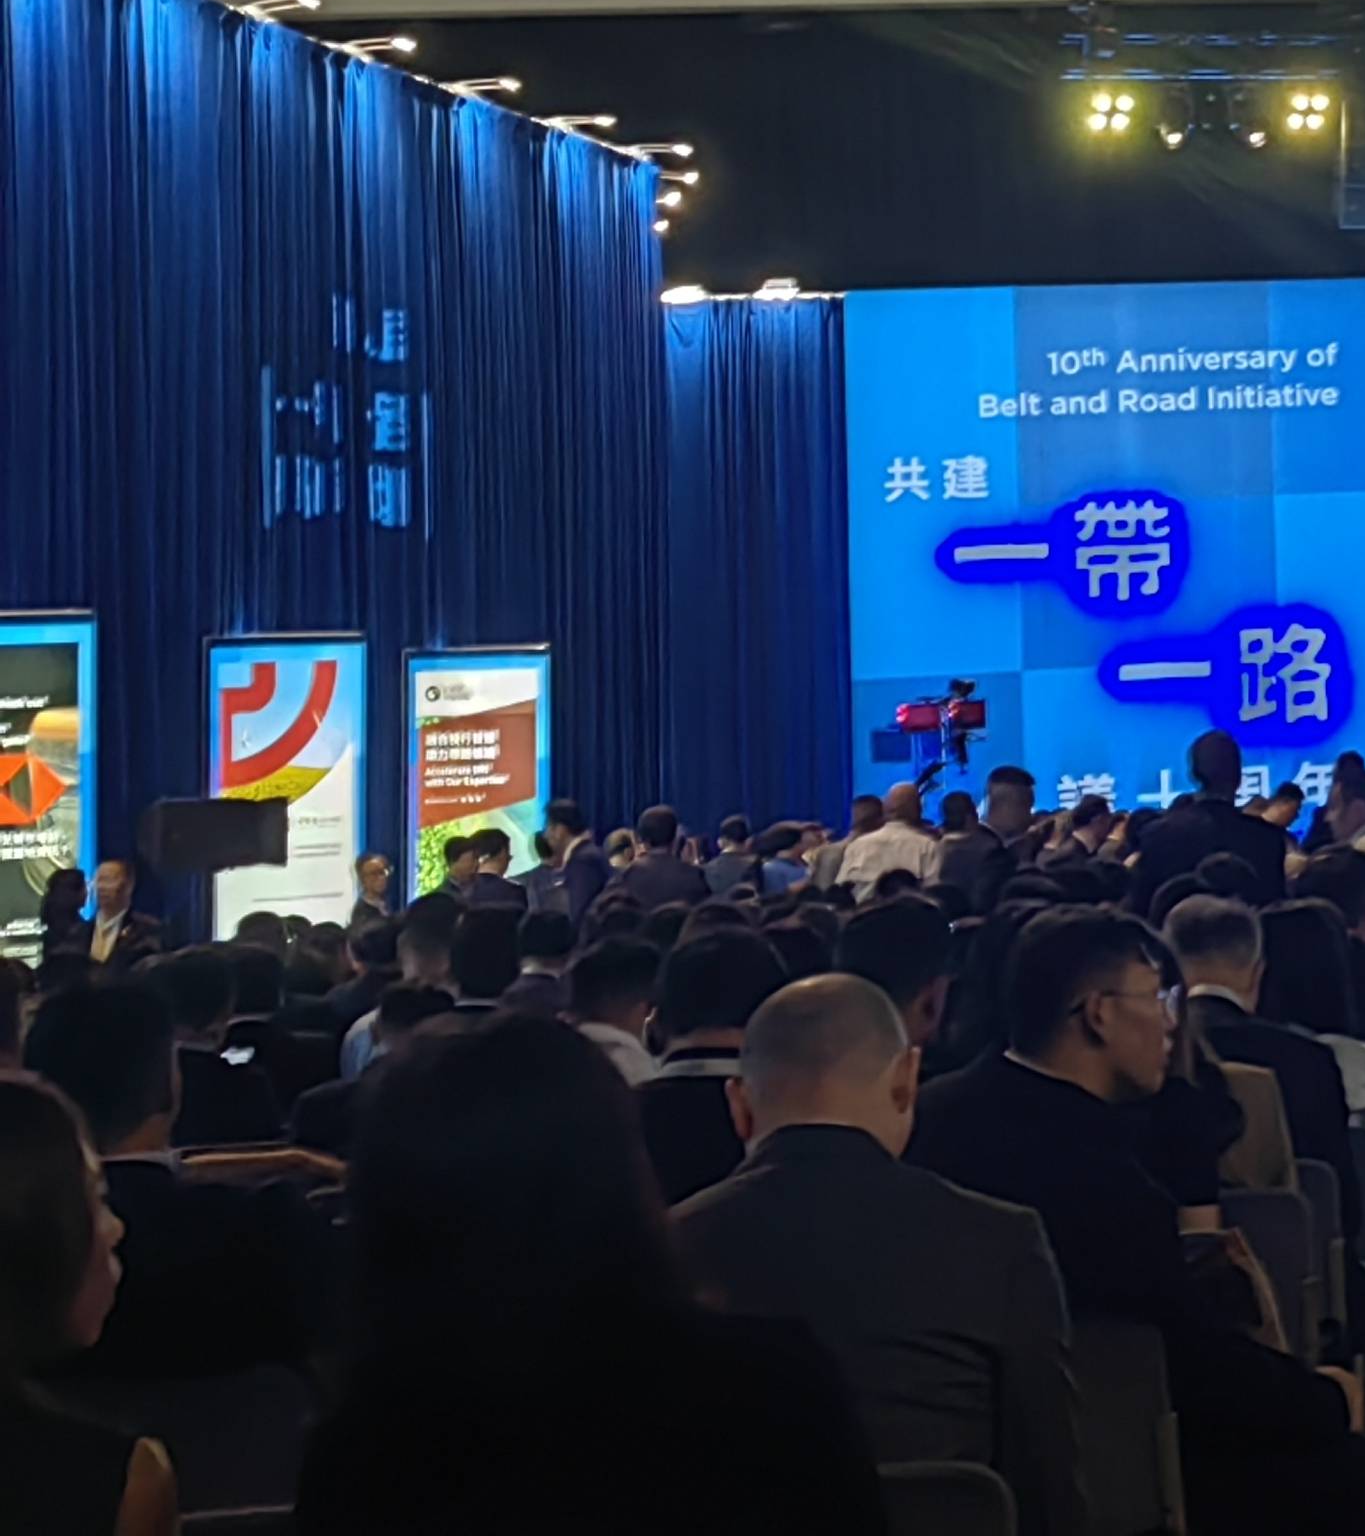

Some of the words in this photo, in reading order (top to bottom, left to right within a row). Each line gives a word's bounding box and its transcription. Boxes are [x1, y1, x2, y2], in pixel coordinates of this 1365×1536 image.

[1115, 346, 1297, 373] Anniversary
[1307, 342, 1340, 366] of
[978, 391, 1042, 418] Belt
[1050, 389, 1107, 414] and
[1118, 385, 1197, 413] Road
[1207, 381, 1340, 410] Initiative
[883, 455, 990, 503] 共建
[953, 498, 1171, 602] 一帶
[1118, 622, 1332, 724] 一路
